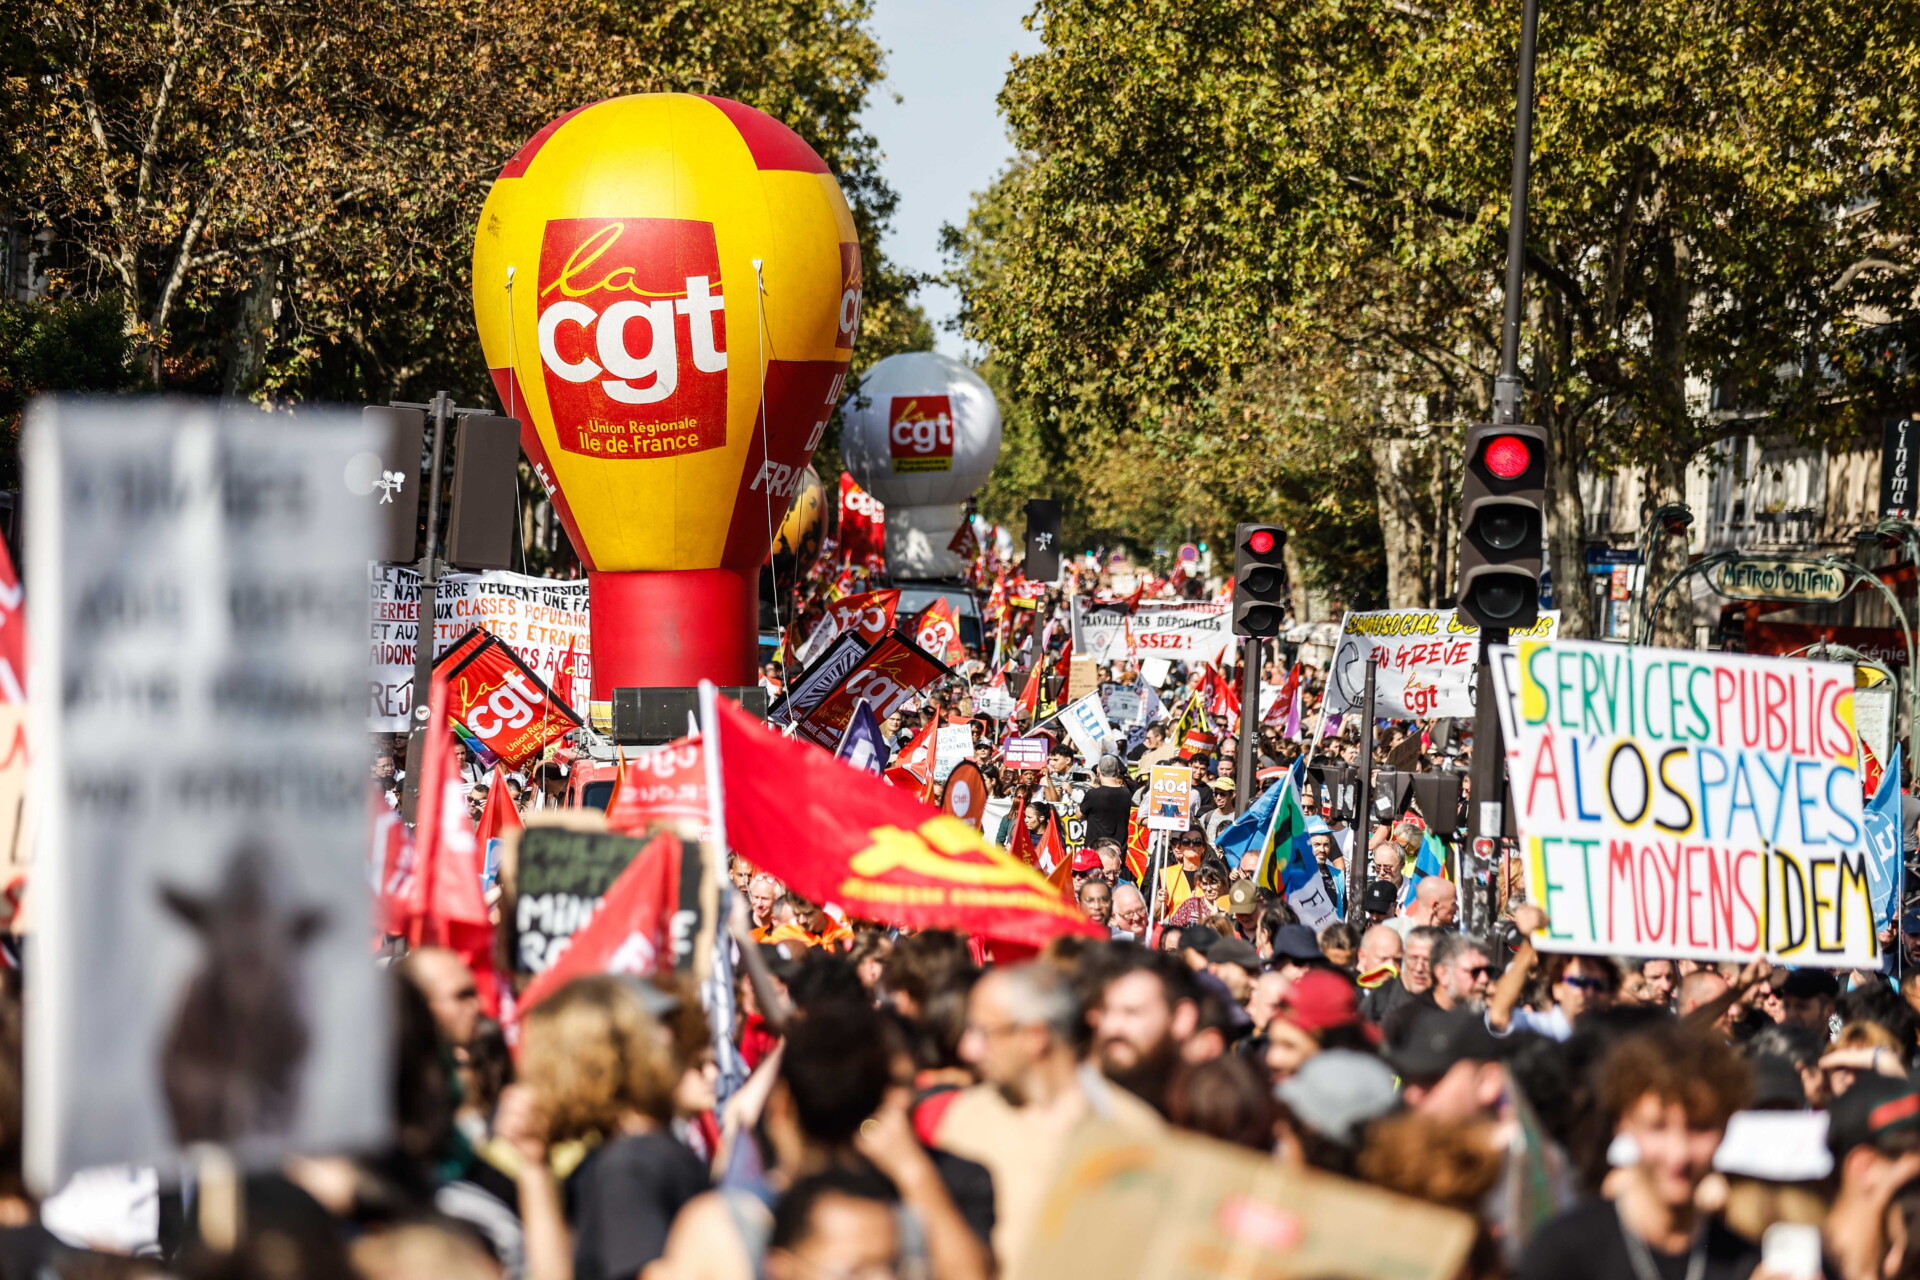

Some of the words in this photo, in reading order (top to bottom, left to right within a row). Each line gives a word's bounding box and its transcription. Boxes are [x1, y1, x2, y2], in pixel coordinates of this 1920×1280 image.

[541, 222, 690, 298] la
[839, 288, 862, 346] cg
[537, 275, 727, 405] cgt
[824, 373, 847, 405] IL
[589, 419, 625, 433] Union
[629, 417, 697, 437] Régionale
[892, 412, 952, 453] cgt
[749, 459, 806, 497] FRA
[372, 565, 393, 583] LE
[370, 584, 388, 600] DE
[394, 583, 469, 601] NANERRE
[544, 593, 568, 611] UNE
[434, 603, 453, 619] UX
[456, 596, 517, 617] CLASSES
[525, 604, 590, 629] POPULAIR
[370, 623, 389, 640] ET
[1081, 615, 1150, 628] TRAVAILLRS
[1345, 614, 1440, 637] SAMUSOCIAL
[1134, 633, 1183, 650] SSEZ
[1369, 646, 1390, 669] EN
[1395, 637, 1473, 674] GRÈVE
[544, 646, 555, 671] À
[460, 670, 506, 718] la
[846, 670, 917, 720] cgt
[1403, 672, 1433, 691] la
[467, 670, 545, 739] cgt
[1403, 685, 1438, 716] cgt
[506, 732, 530, 752] Union
[1153, 778, 1188, 795] 404
[1526, 721, 1565, 820] À
[1698, 744, 1861, 848] PAYES
[1541, 837, 1600, 941] ET
[1608, 838, 1759, 953] MOYENS
